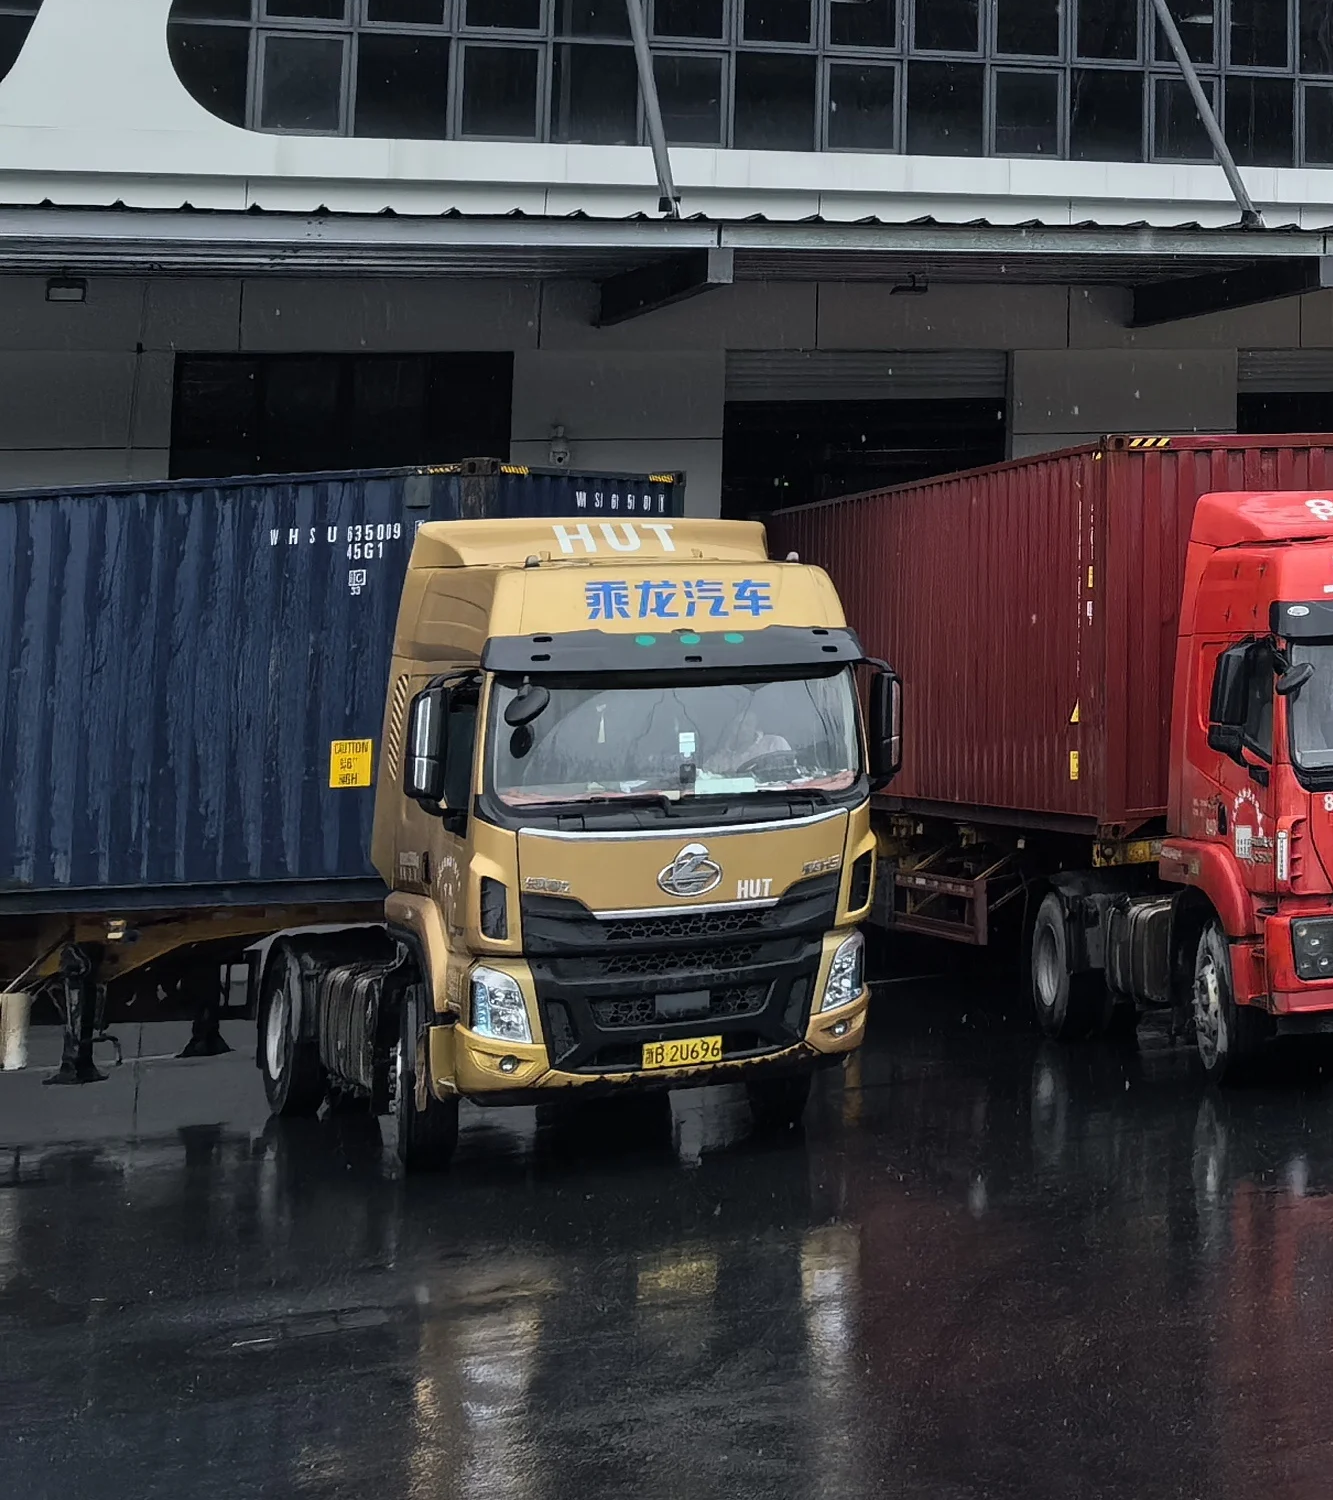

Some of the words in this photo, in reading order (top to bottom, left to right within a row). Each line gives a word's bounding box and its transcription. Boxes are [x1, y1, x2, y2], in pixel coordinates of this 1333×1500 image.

[552, 523, 676, 554] HUT
[584, 579, 774, 620] 乘龙汽车
[737, 878, 773, 899] HUT
